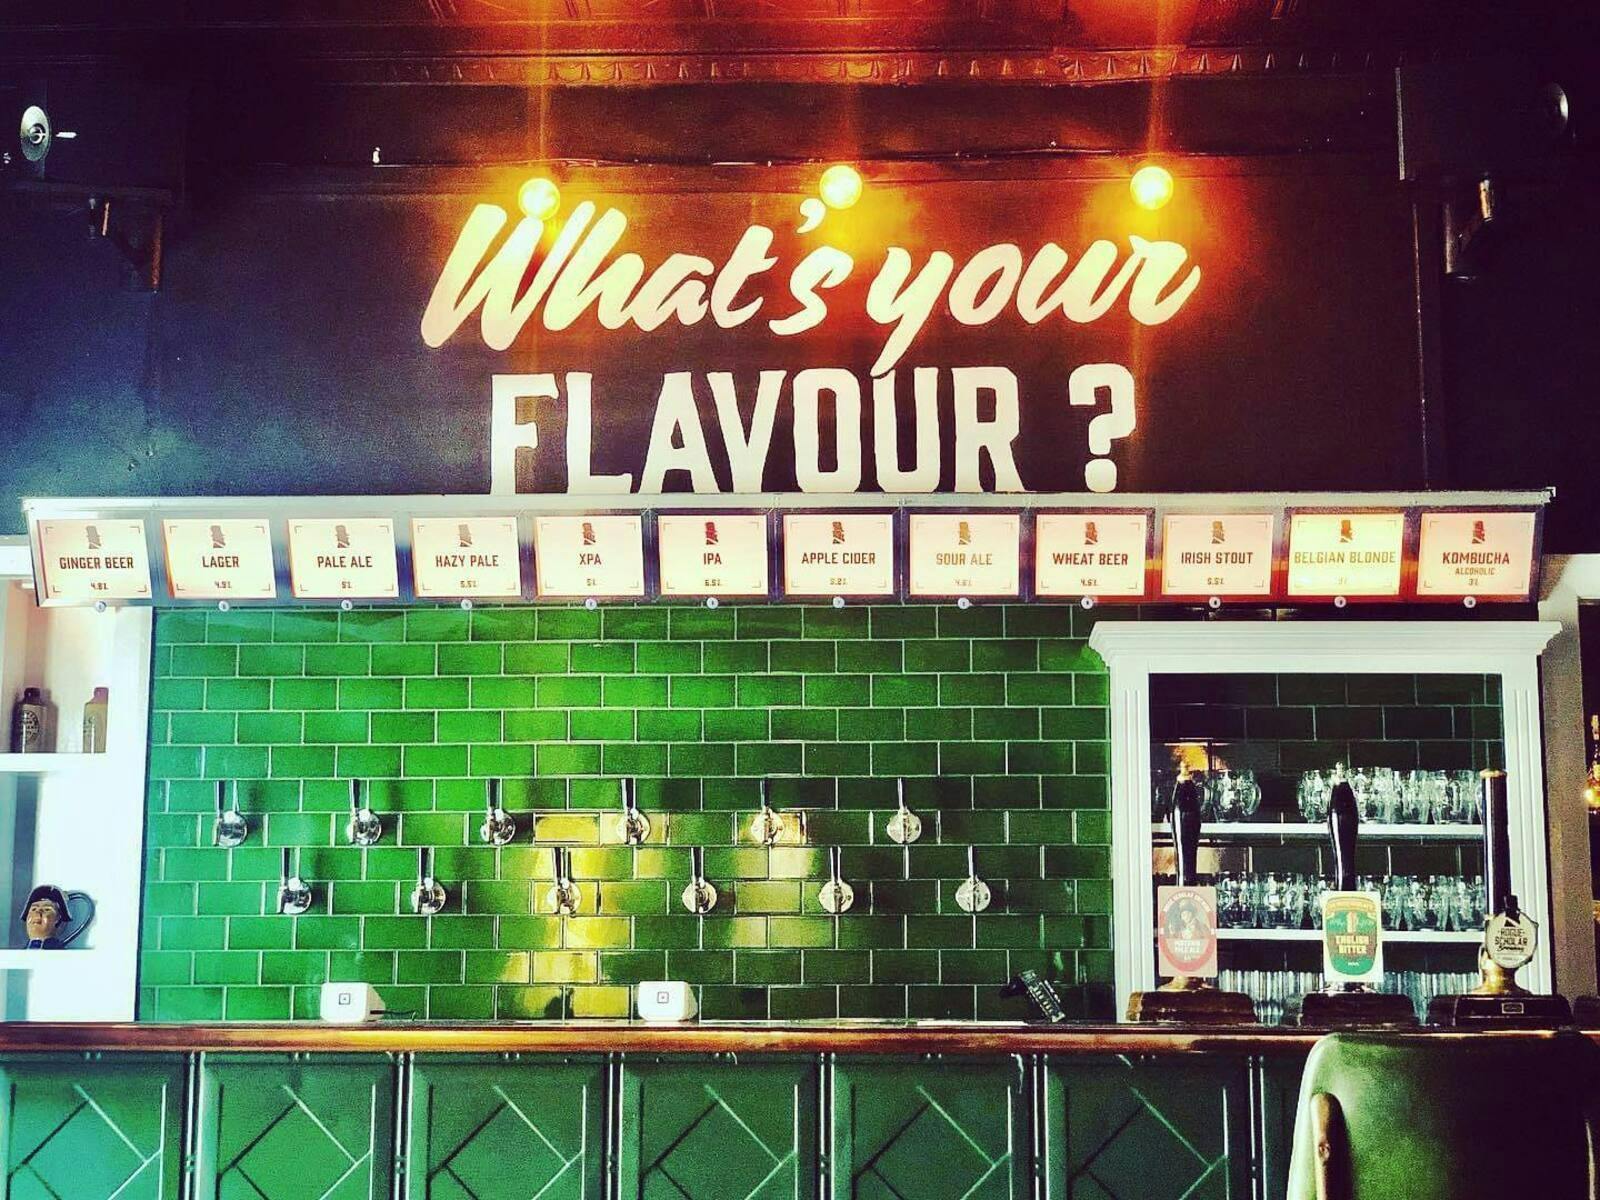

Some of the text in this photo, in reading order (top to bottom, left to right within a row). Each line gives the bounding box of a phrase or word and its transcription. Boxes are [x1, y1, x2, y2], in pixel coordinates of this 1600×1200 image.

[421, 198, 1201, 376] What's your
[490, 365, 1027, 493] FLAVOUR
[59, 556, 134, 570] GINGER BEER
[201, 555, 240, 568] LAGER
[316, 555, 373, 569] PALE ALE
[435, 554, 499, 568] HAZY PALE
[579, 553, 602, 566] XPA
[703, 552, 722, 565] IPA
[801, 552, 876, 565] APPLE CIDER
[936, 552, 993, 566] SOUR ALE
[1052, 552, 1129, 566] WHEAT BEER
[1180, 551, 1254, 565] IRISH STOUT
[1293, 551, 1396, 564] BELGIAN BLONDE
[1442, 551, 1510, 565] KOMBUCHA
[1494, 936, 1528, 946] SCHOLAR
[1338, 945, 1367, 954] BITTER
